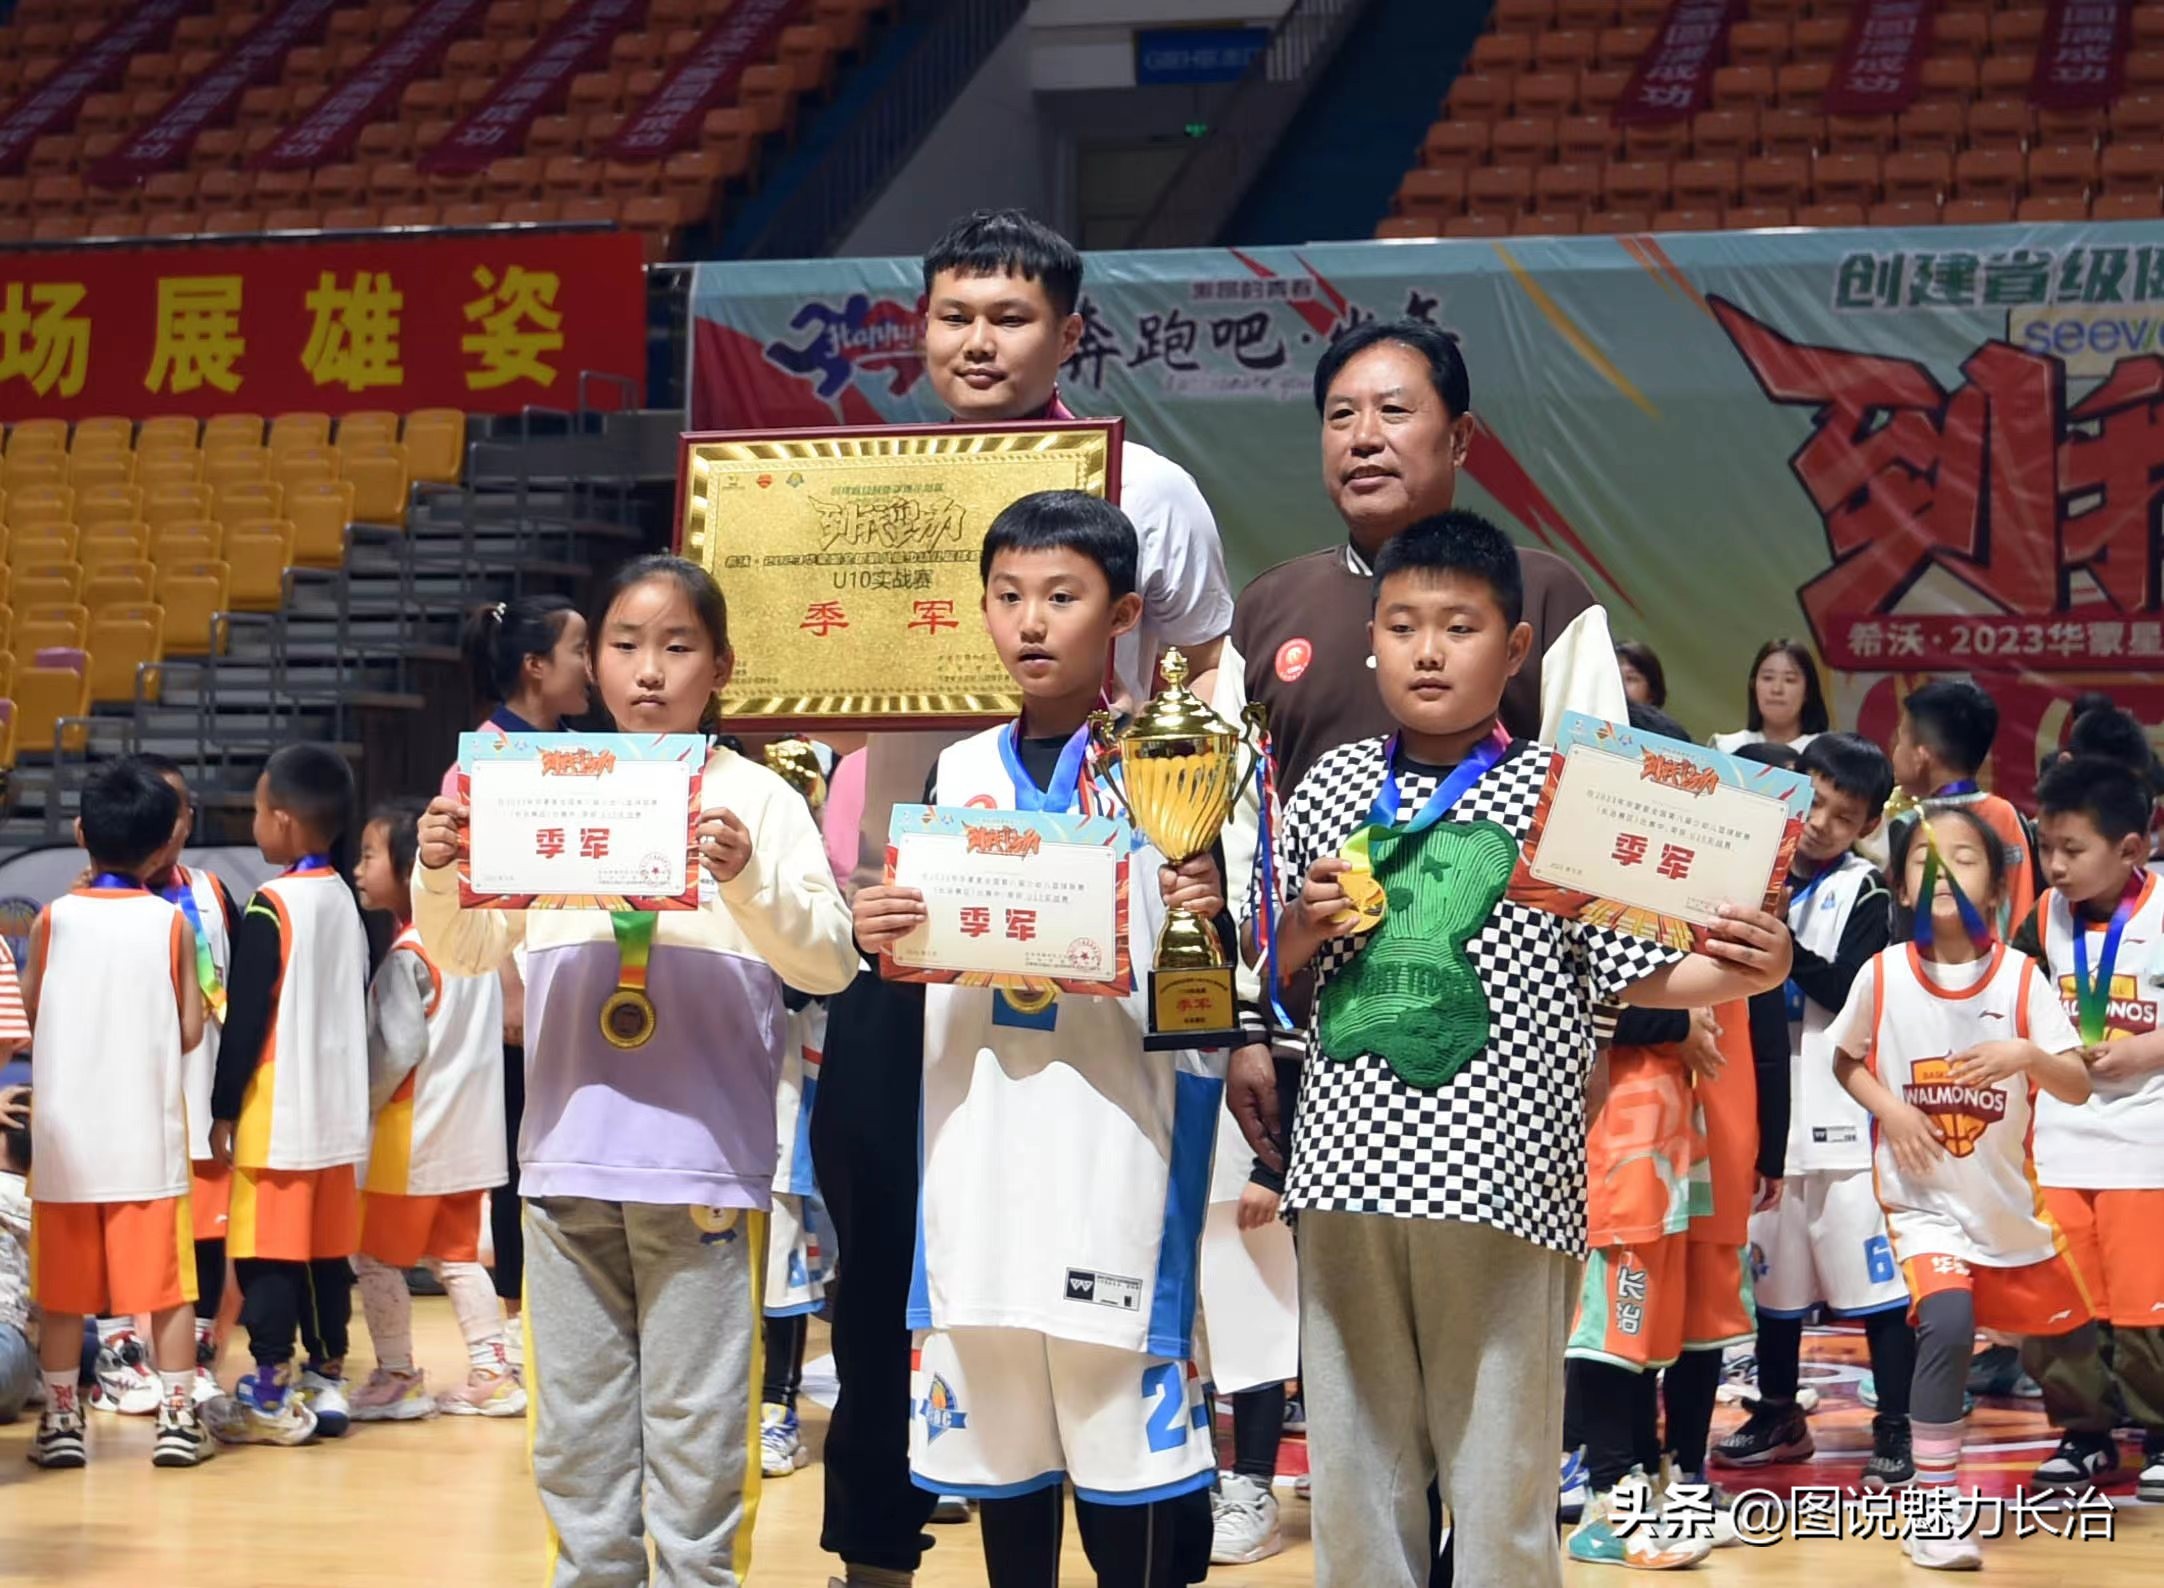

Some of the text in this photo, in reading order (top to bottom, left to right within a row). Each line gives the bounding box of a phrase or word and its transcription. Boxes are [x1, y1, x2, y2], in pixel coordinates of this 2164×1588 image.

[0, 264, 564, 397] 场展雄姿
[833, 568, 933, 590] U10实战赛
[800, 600, 960, 637] 季军
[536, 828, 610, 859] 季军
[1611, 832, 1695, 880] 季军
[960, 907, 1037, 942] 季军
[1142, 1361, 1187, 1453] 2
